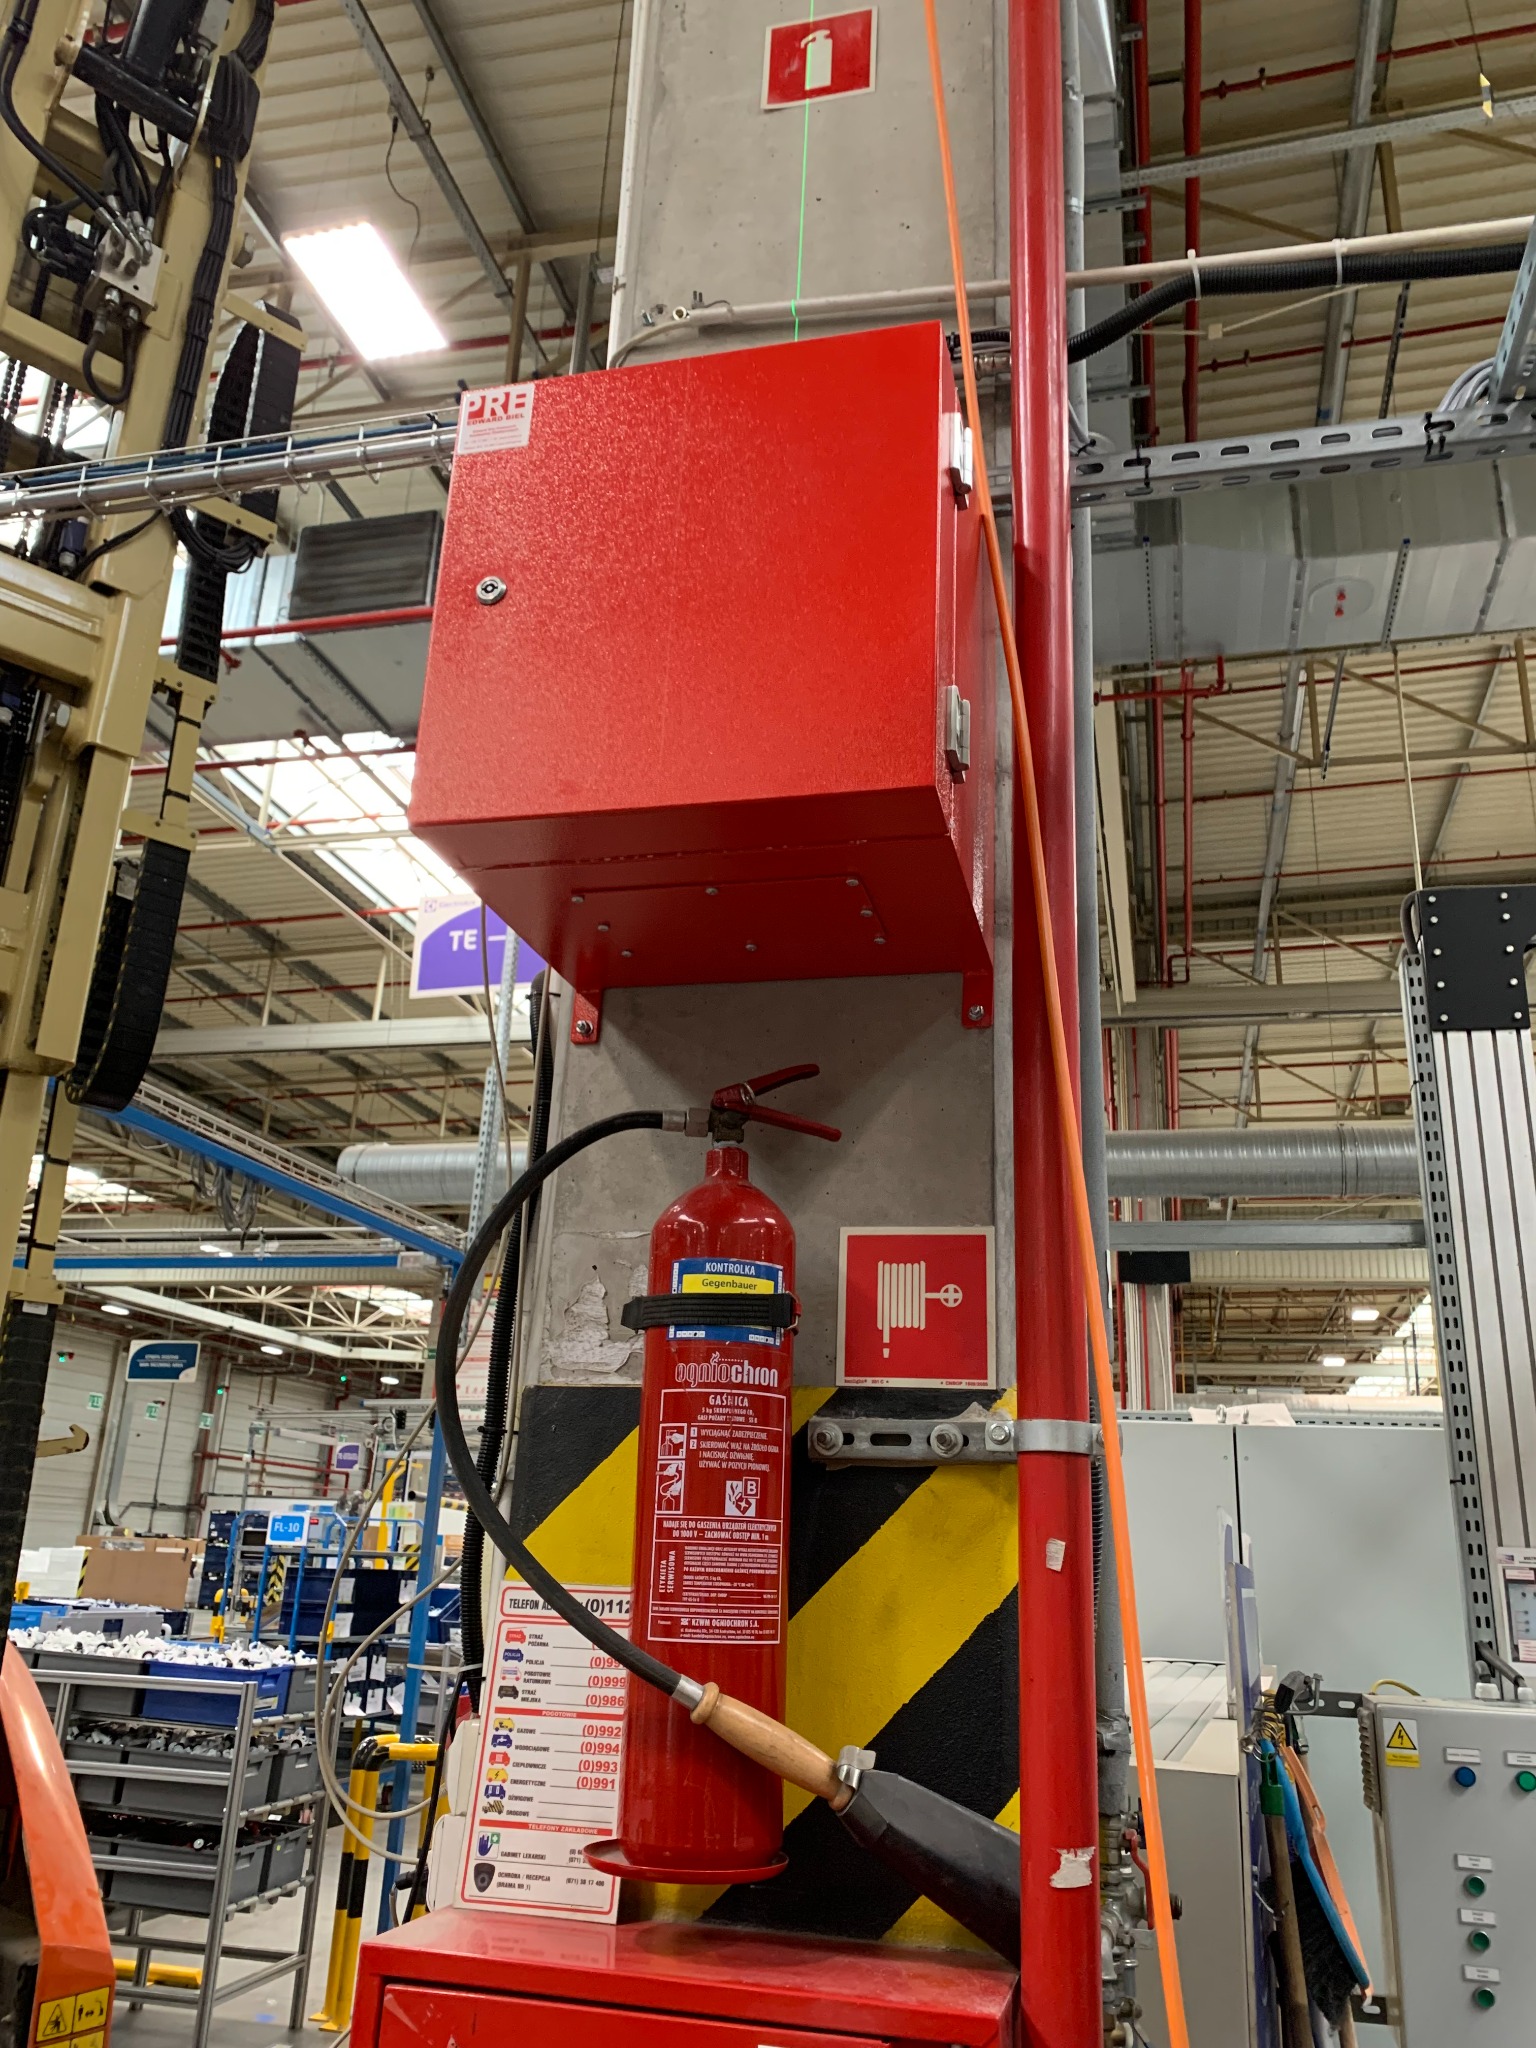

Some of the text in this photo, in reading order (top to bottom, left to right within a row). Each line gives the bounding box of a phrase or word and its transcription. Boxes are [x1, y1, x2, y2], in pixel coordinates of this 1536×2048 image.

[468, 391, 527, 420] PRE
[467, 412, 525, 426] EDWARD BIEL
[449, 929, 478, 952] TE
[705, 1262, 755, 1275] KONTROLKA
[702, 1278, 757, 1291] Gegenbauer
[675, 1359, 778, 1388] ogniochron
[709, 1393, 749, 1407] GAŚNICA
[747, 1481, 757, 1495] B
[273, 1521, 301, 1533] FL-10
[696, 1521, 721, 1530] GASZENIA
[704, 1531, 731, 1539] ZACHOWAĆ
[658, 1559, 667, 1593] ETYKIETA
[666, 1550, 676, 1593] SERWISOWA
[509, 1598, 540, 1610] TELEFON
[711, 1619, 749, 1628] OGNIOCHRON
[749, 1620, 760, 1628] S.A.
[590, 1657, 625, 1669] (0)99
[587, 1676, 627, 1689] (0)999
[585, 1694, 625, 1708] (0)986
[542, 1710, 577, 1718] POGOTOWIE
[582, 1724, 622, 1738] (0)992
[514, 1742, 620, 1756] WODOCIĄGOWE (0)994
[512, 1759, 618, 1773] CIEPŁOWNICZE (0)993
[510, 1776, 616, 1790] ENERGETYCZNE (0)991
[508, 1793, 534, 1802] DŹWIGOWE
[506, 1809, 530, 1817] DROGOWE
[528, 1823, 599, 1835] TELEFONY ZAKŁADOWE
[500, 1851, 521, 1859] GABINET
[522, 1852, 546, 1860] LEKARSKI
[497, 1871, 521, 1879] OCHRONA
[525, 1873, 551, 1882] RECEPCJA
[496, 1881, 516, 1889] (BRAMA
